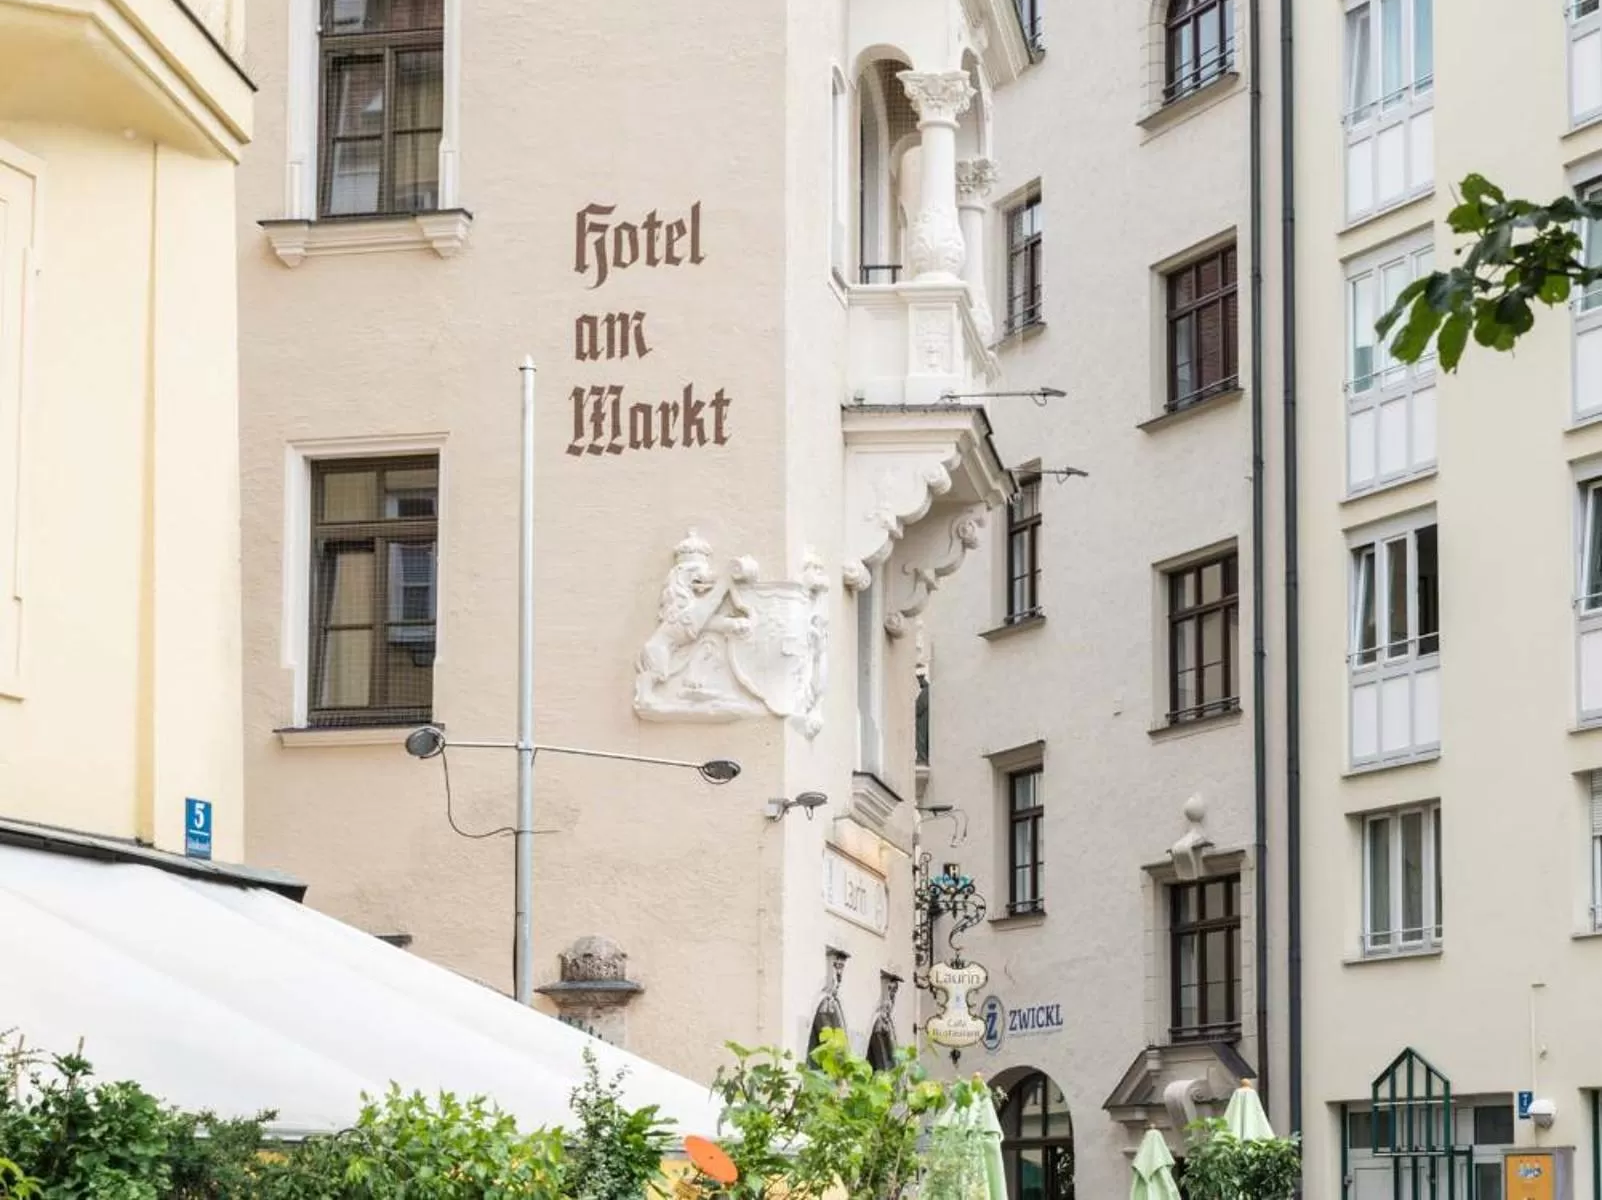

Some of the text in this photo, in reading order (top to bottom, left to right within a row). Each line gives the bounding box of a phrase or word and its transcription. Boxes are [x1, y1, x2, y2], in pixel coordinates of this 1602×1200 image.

[574, 201, 706, 290] Hotel
[575, 311, 652, 361] am
[566, 382, 732, 456] Markt
[195, 803, 205, 828] 5
[935, 970, 980, 984] Laurin
[1008, 1003, 1064, 1031] ZWICKL
